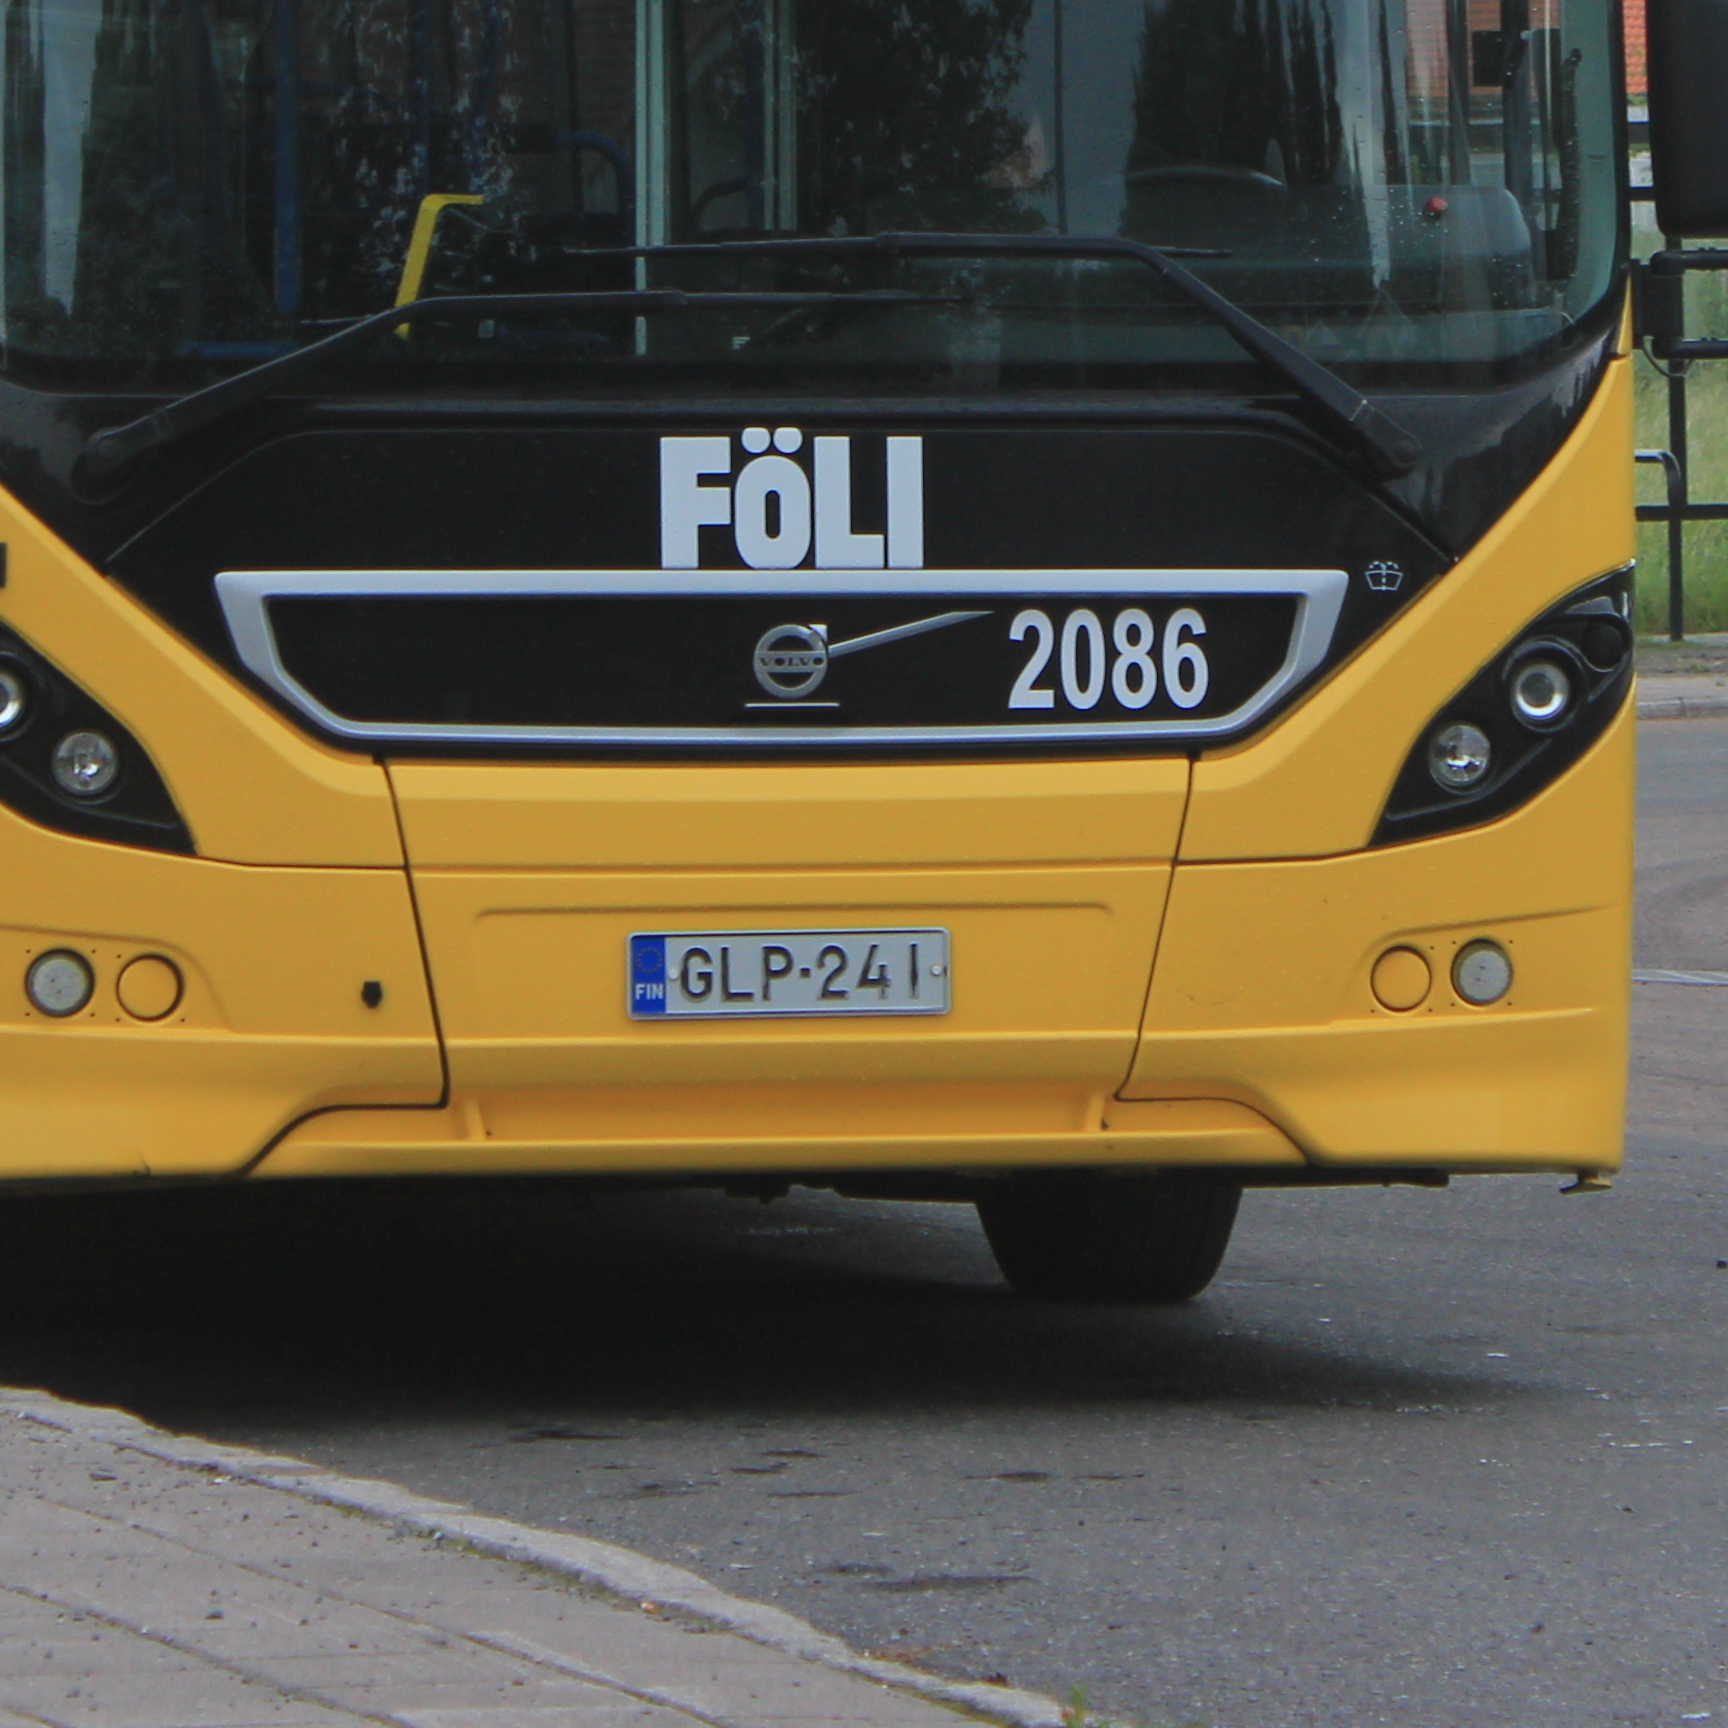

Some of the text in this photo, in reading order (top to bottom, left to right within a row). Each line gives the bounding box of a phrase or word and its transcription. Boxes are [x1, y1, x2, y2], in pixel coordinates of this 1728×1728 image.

[660, 427, 924, 570] FÖLI
[758, 656, 825, 667] VOLVO
[1008, 607, 1209, 710] 2086
[635, 983, 664, 1001] FIN
[680, 941, 920, 1002] GLP-241
